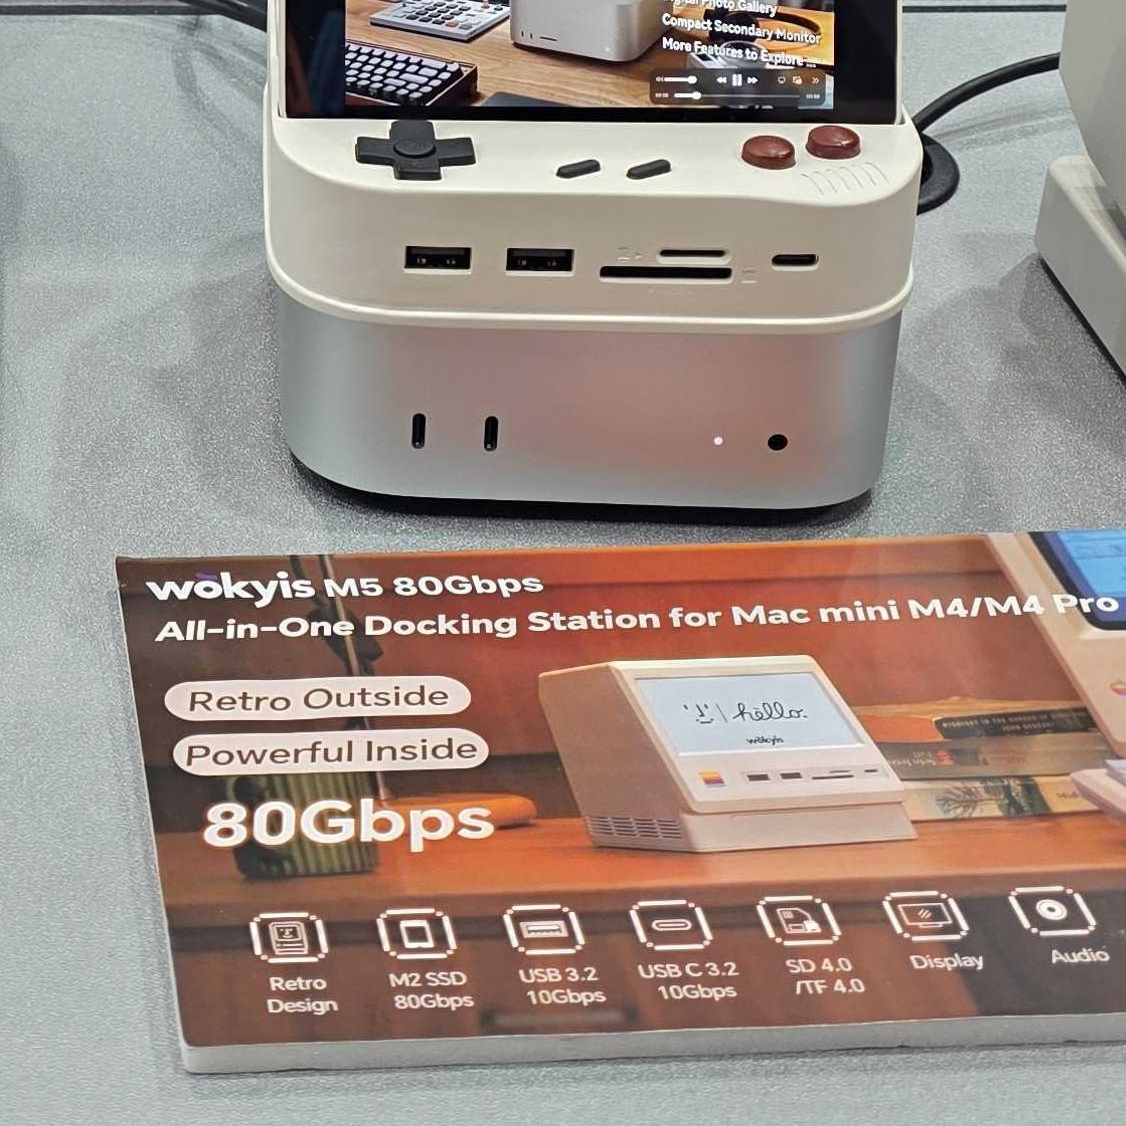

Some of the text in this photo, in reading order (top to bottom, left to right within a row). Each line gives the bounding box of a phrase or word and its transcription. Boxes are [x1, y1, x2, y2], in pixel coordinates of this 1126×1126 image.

[738, 0, 777, 18] Gallery
[662, 14, 821, 44] Compact Secondary Monitor
[663, 38, 691, 51] More
[694, 41, 743, 59] Features
[745, 47, 758, 60] to
[760, 50, 803, 66] Explore
[324, 577, 384, 598] M5
[393, 575, 545, 599] 80Gbps
[154, 593, 1120, 642] All-in-One Docking Station for Mac mini M4/M4 Pro
[188, 685, 450, 713] Retro Outside
[185, 737, 478, 767] Powerful Inside
[203, 797, 496, 853] 80Gbps
[910, 953, 984, 972] Display
[1050, 946, 1110, 965] Audio
[638, 961, 740, 979] USB C 3.2
[785, 957, 853, 974] SD 4.0
[270, 976, 327, 992] Retro
[389, 972, 468, 987] M2 SSD
[518, 967, 599, 984] USB 3.2
[657, 984, 738, 1002] 10Gbps
[795, 978, 865, 995] /TF 4.0
[394, 994, 474, 1012] 80Gbps
[526, 989, 606, 1007] 10Gbps
[267, 999, 338, 1016] Design
